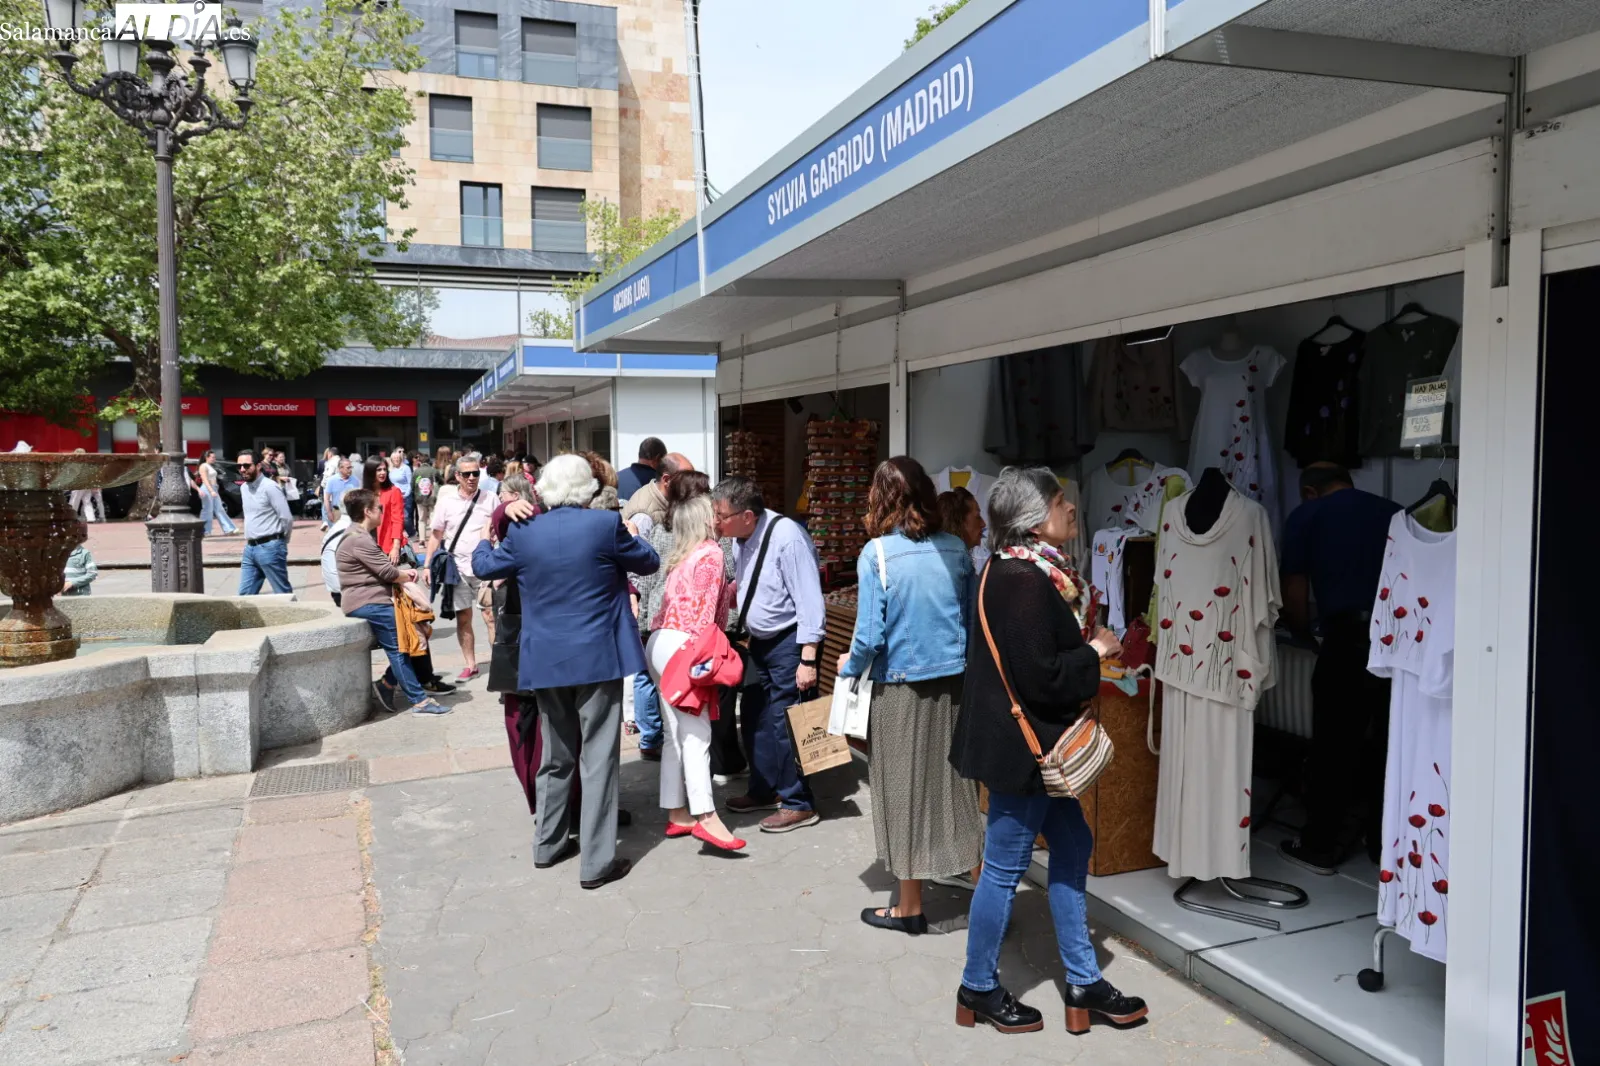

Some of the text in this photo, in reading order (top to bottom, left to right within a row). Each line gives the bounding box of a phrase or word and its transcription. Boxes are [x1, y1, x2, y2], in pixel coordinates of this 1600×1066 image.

[767, 56, 974, 225] SYLVIA GARRIDO (MADRID)
[1414, 384, 1427, 394] HAY
[253, 402, 299, 411] Santander
[357, 403, 401, 412] Santander
